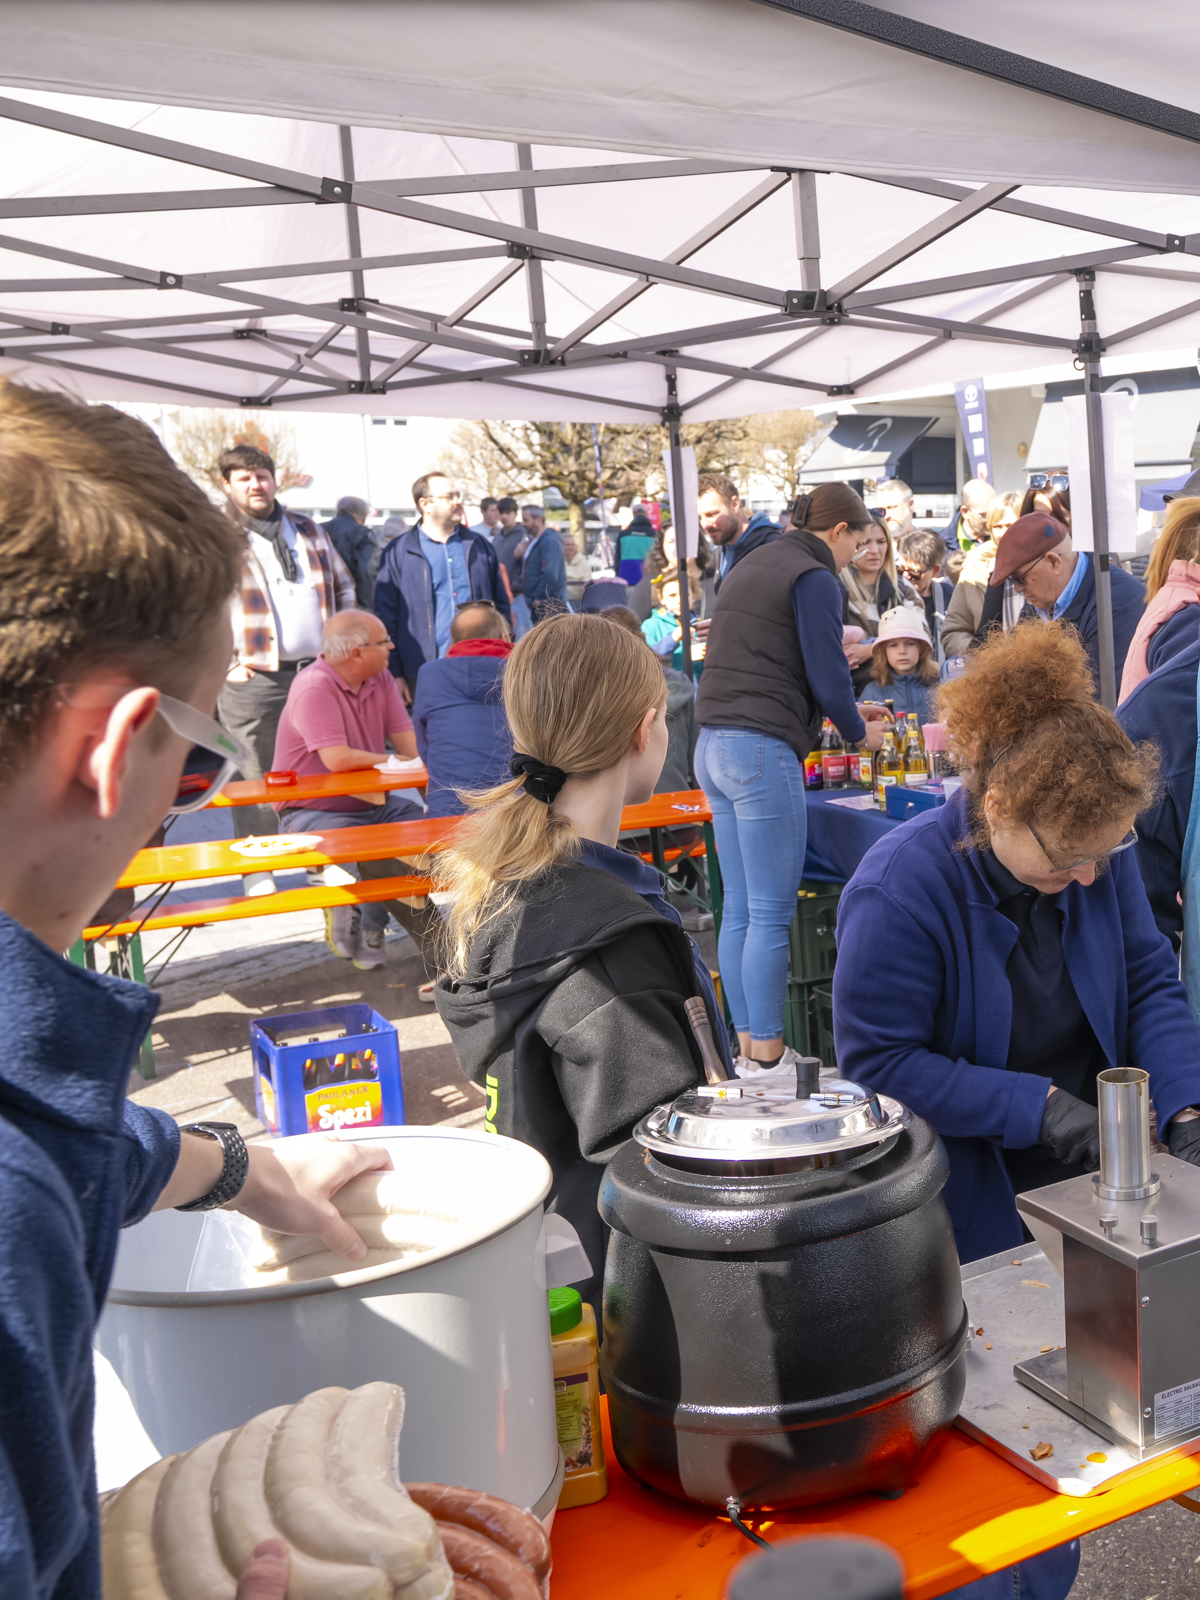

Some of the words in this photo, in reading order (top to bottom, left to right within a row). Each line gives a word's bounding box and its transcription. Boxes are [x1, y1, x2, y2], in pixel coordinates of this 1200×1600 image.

[317, 1086, 368, 1101] PAULANER
[317, 1101, 372, 1130] Spezi
[1161, 1387, 1183, 1399] ELECTRIC
